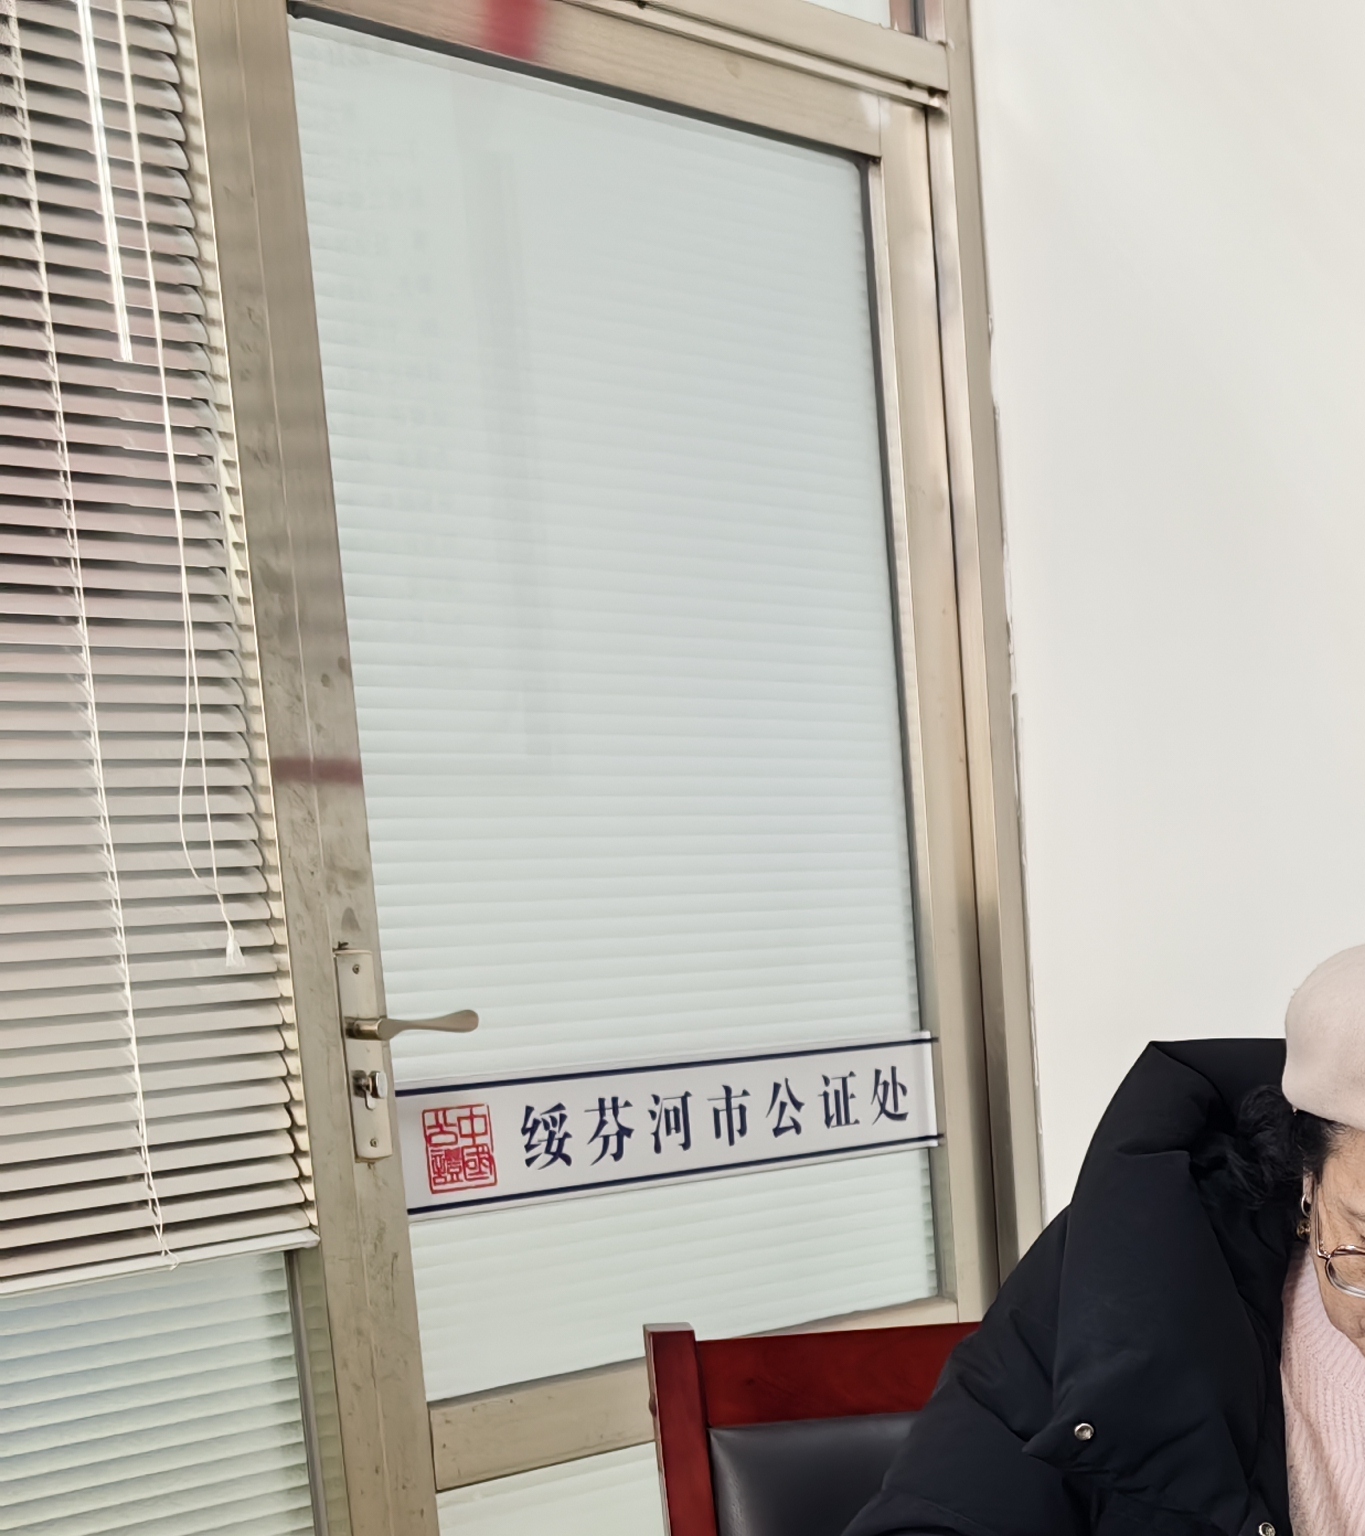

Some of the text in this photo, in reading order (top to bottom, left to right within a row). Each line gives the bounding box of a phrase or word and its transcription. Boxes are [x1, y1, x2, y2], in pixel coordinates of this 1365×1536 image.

[520, 1066, 909, 1170] 绥芬河市公证处
